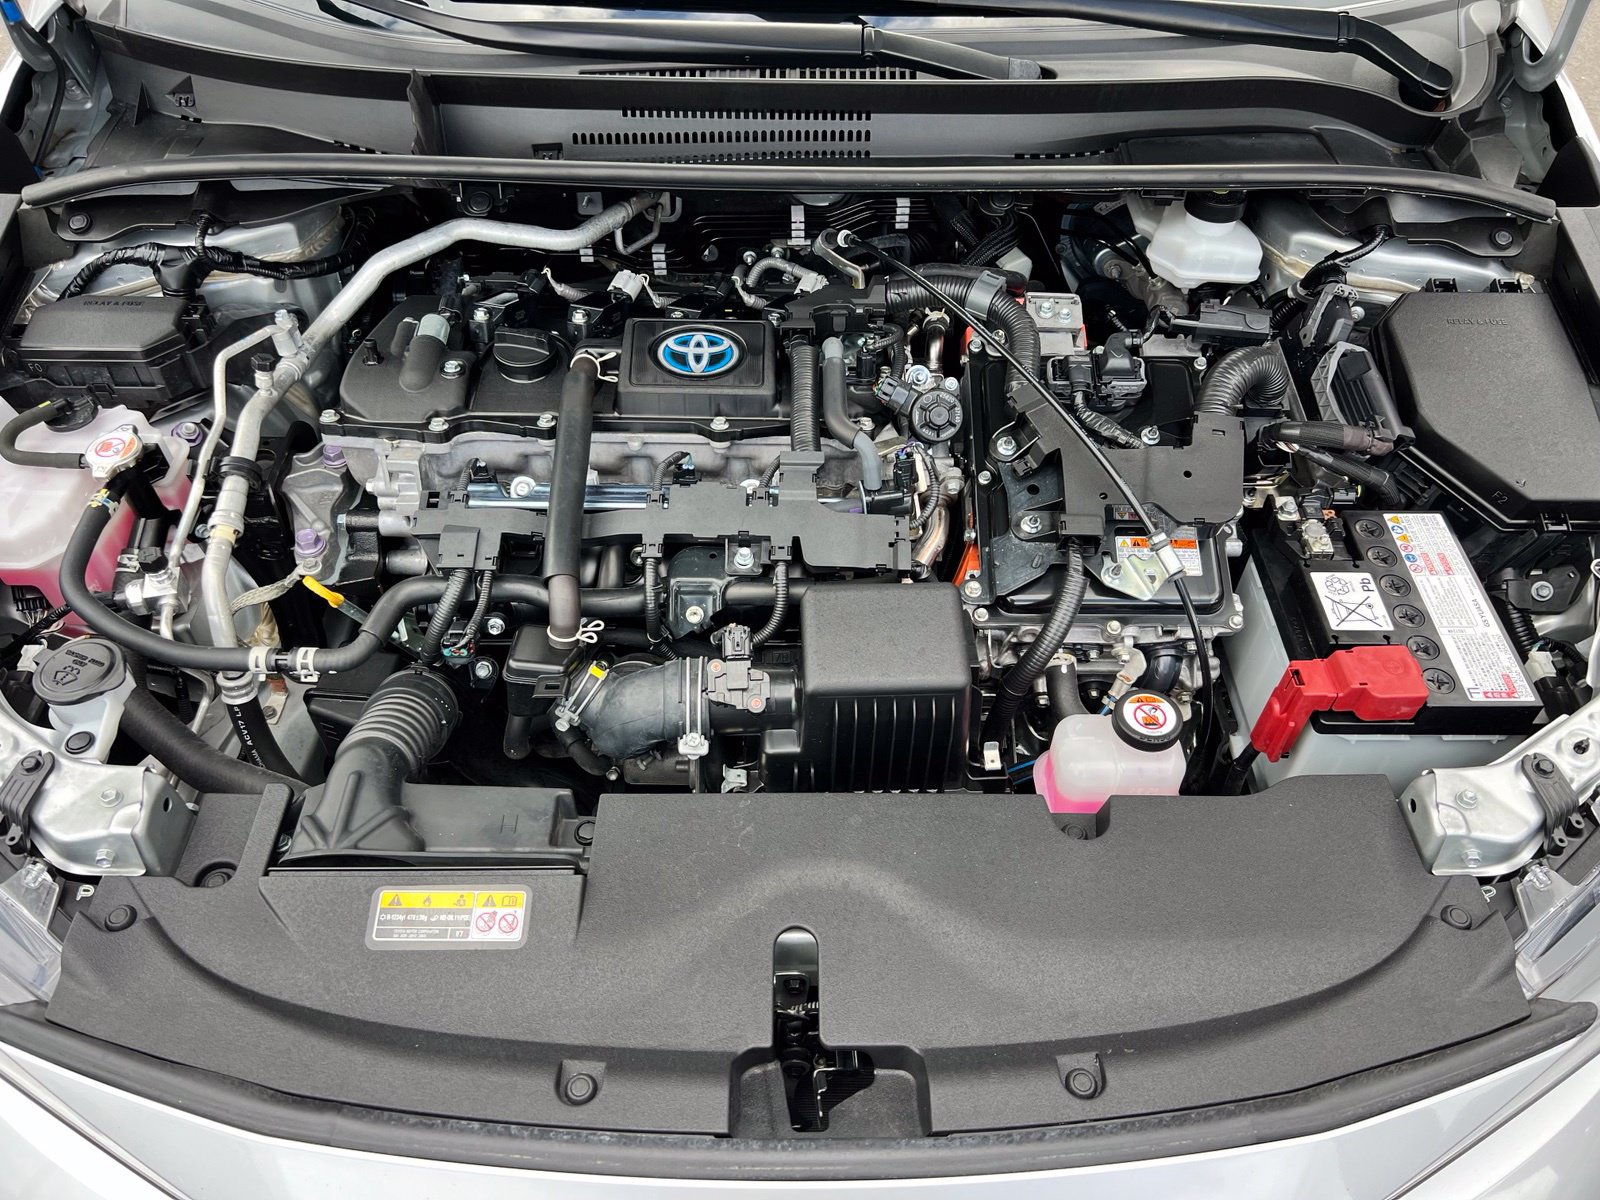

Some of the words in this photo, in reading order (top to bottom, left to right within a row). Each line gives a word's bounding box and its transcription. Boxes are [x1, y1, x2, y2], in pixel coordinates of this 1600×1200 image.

[1491, 490, 1508, 504] F2
[1360, 578, 1374, 592] Pb
[233, 706, 242, 717] LP
[238, 720, 253, 746] ACV17
